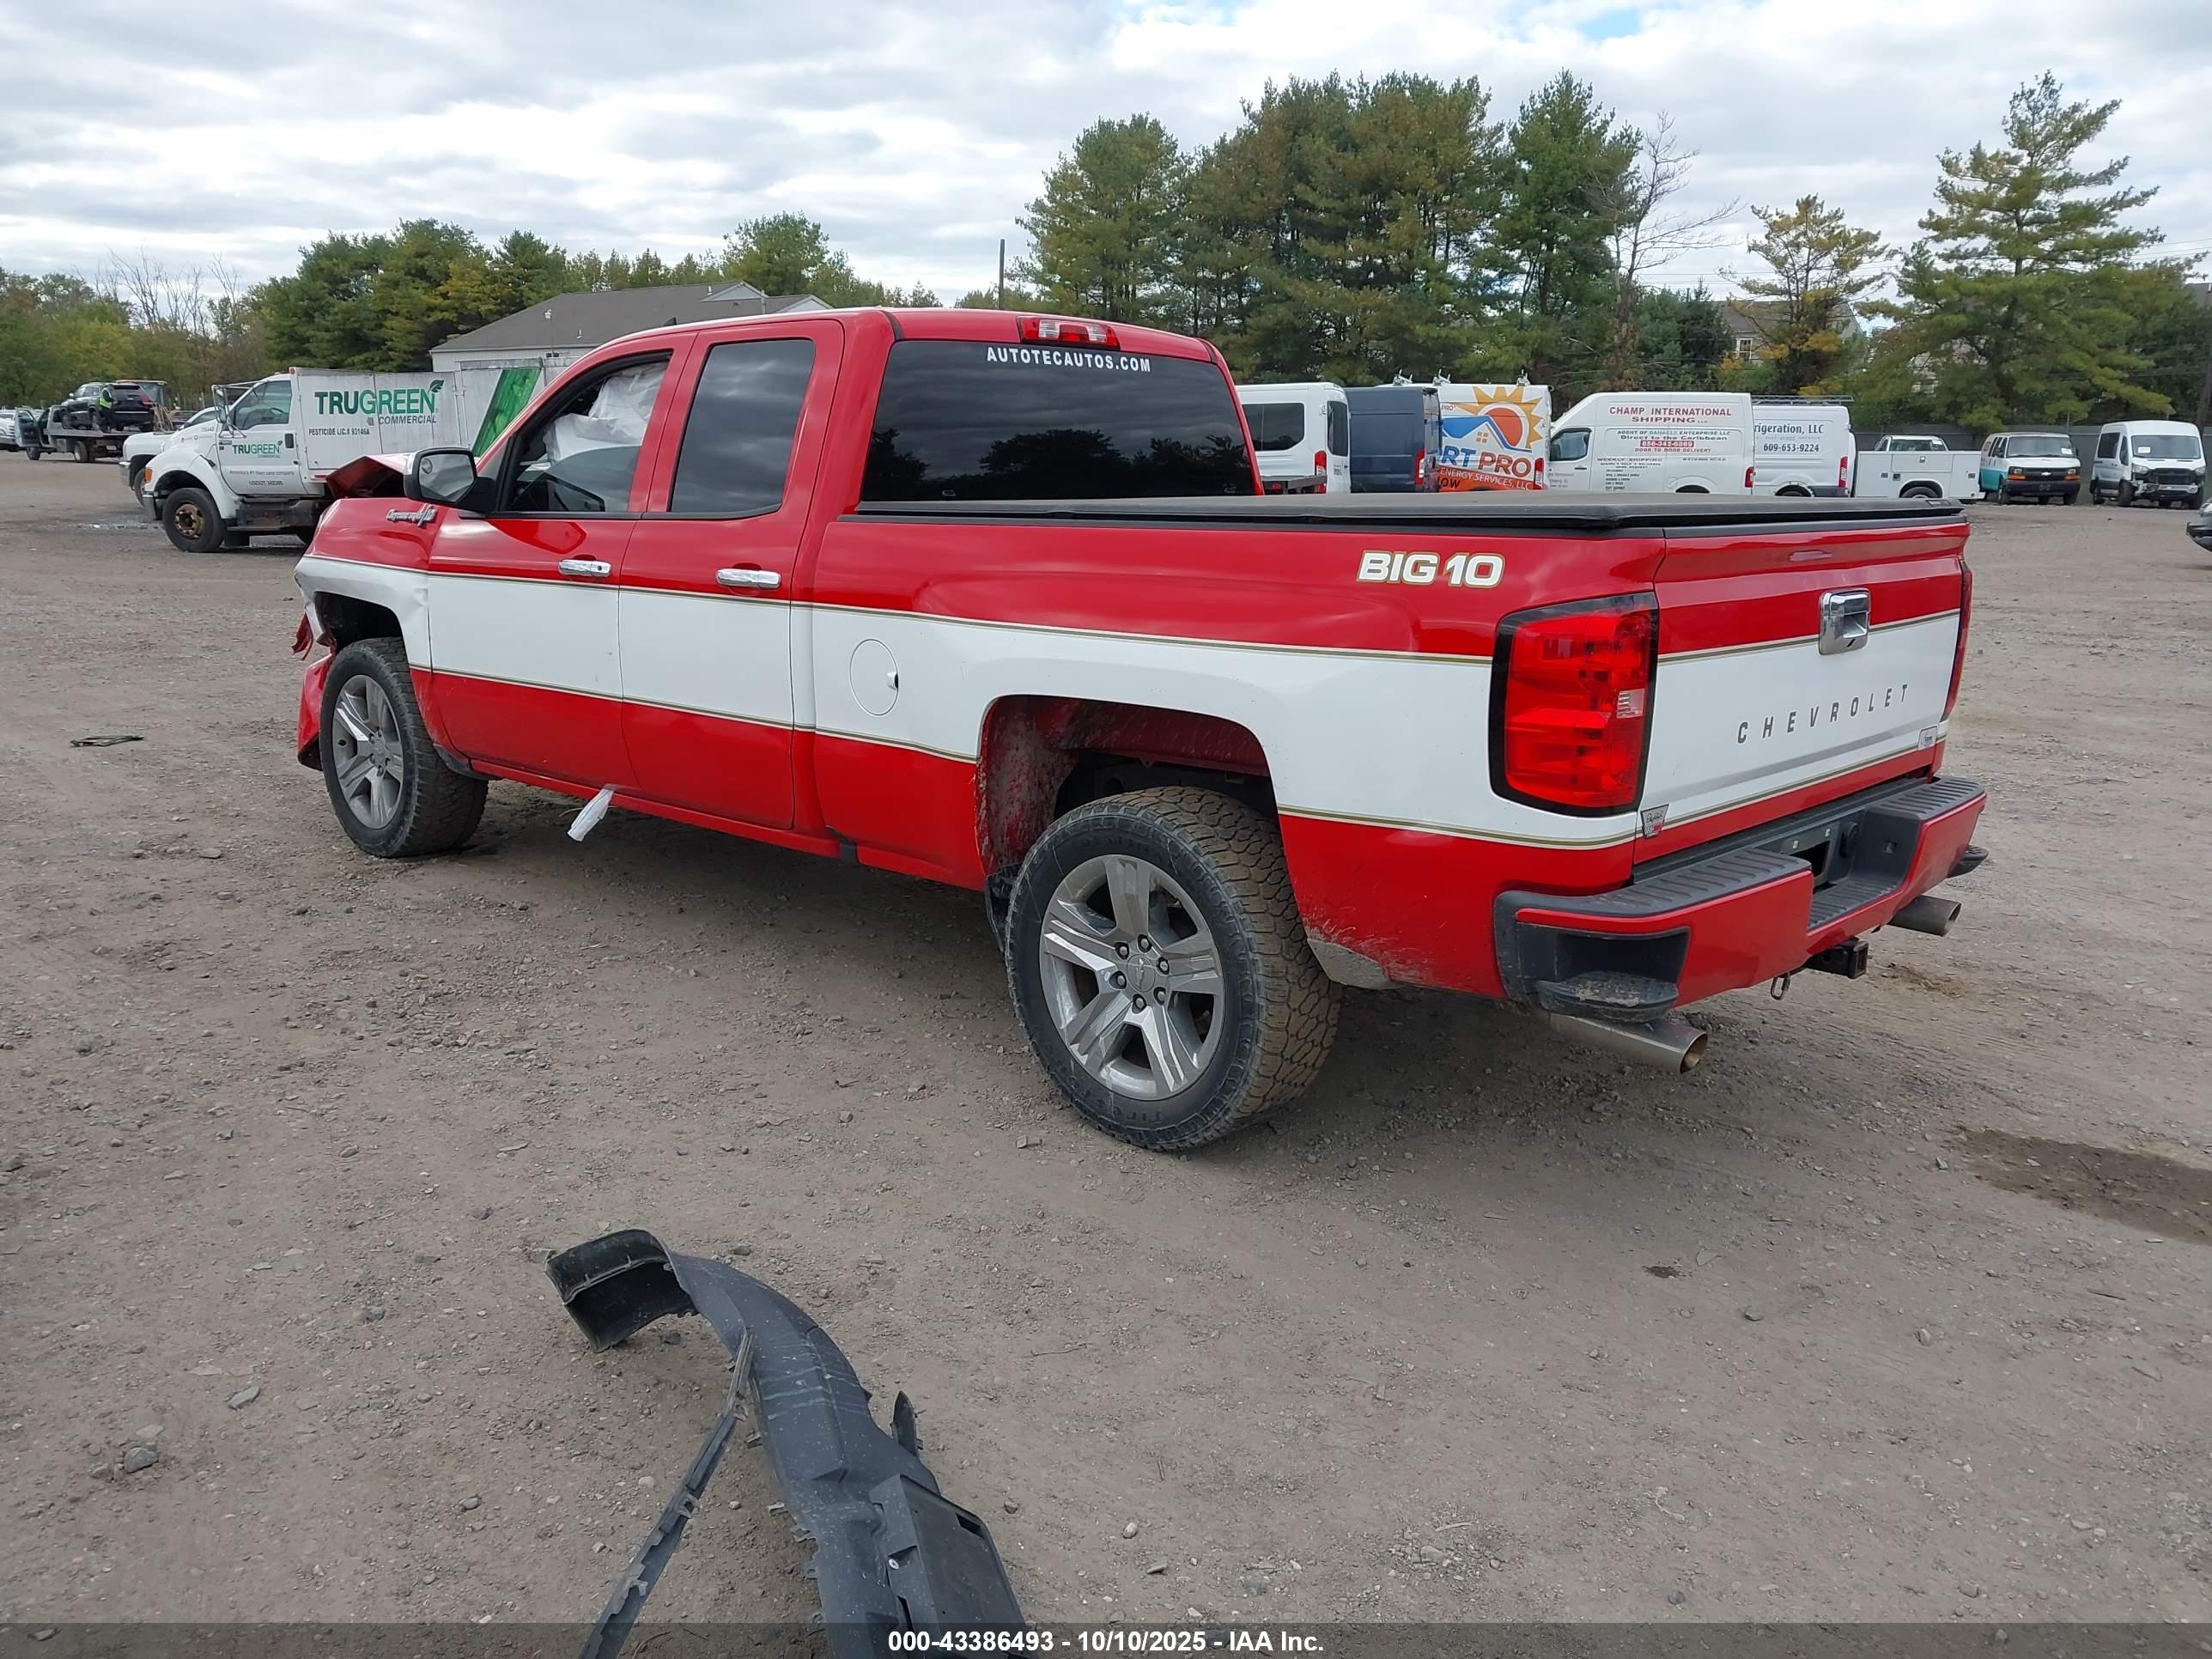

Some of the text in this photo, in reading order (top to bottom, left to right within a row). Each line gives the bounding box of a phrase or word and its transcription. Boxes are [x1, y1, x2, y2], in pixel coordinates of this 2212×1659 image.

[987, 347, 1152, 373] AUTOTECAUTOS.COM
[314, 388, 435, 415] TRUGREEN
[1609, 406, 1732, 416] CHAMP INTERNATIONAL
[378, 416, 437, 426] COMMERCIAL
[308, 428, 336, 436] PESTICIDE
[1808, 424, 1825, 434] LLC
[232, 444, 280, 454] TRUGREEN
[1763, 443, 1820, 453] 609-653-9224
[1439, 445, 1532, 477] RT PRO
[1441, 467, 1474, 481] ENERGY
[1474, 473, 1515, 488] SERVICES,
[1357, 550, 1506, 588] BIG 10
[1736, 684, 1908, 744] CHEVROLET
